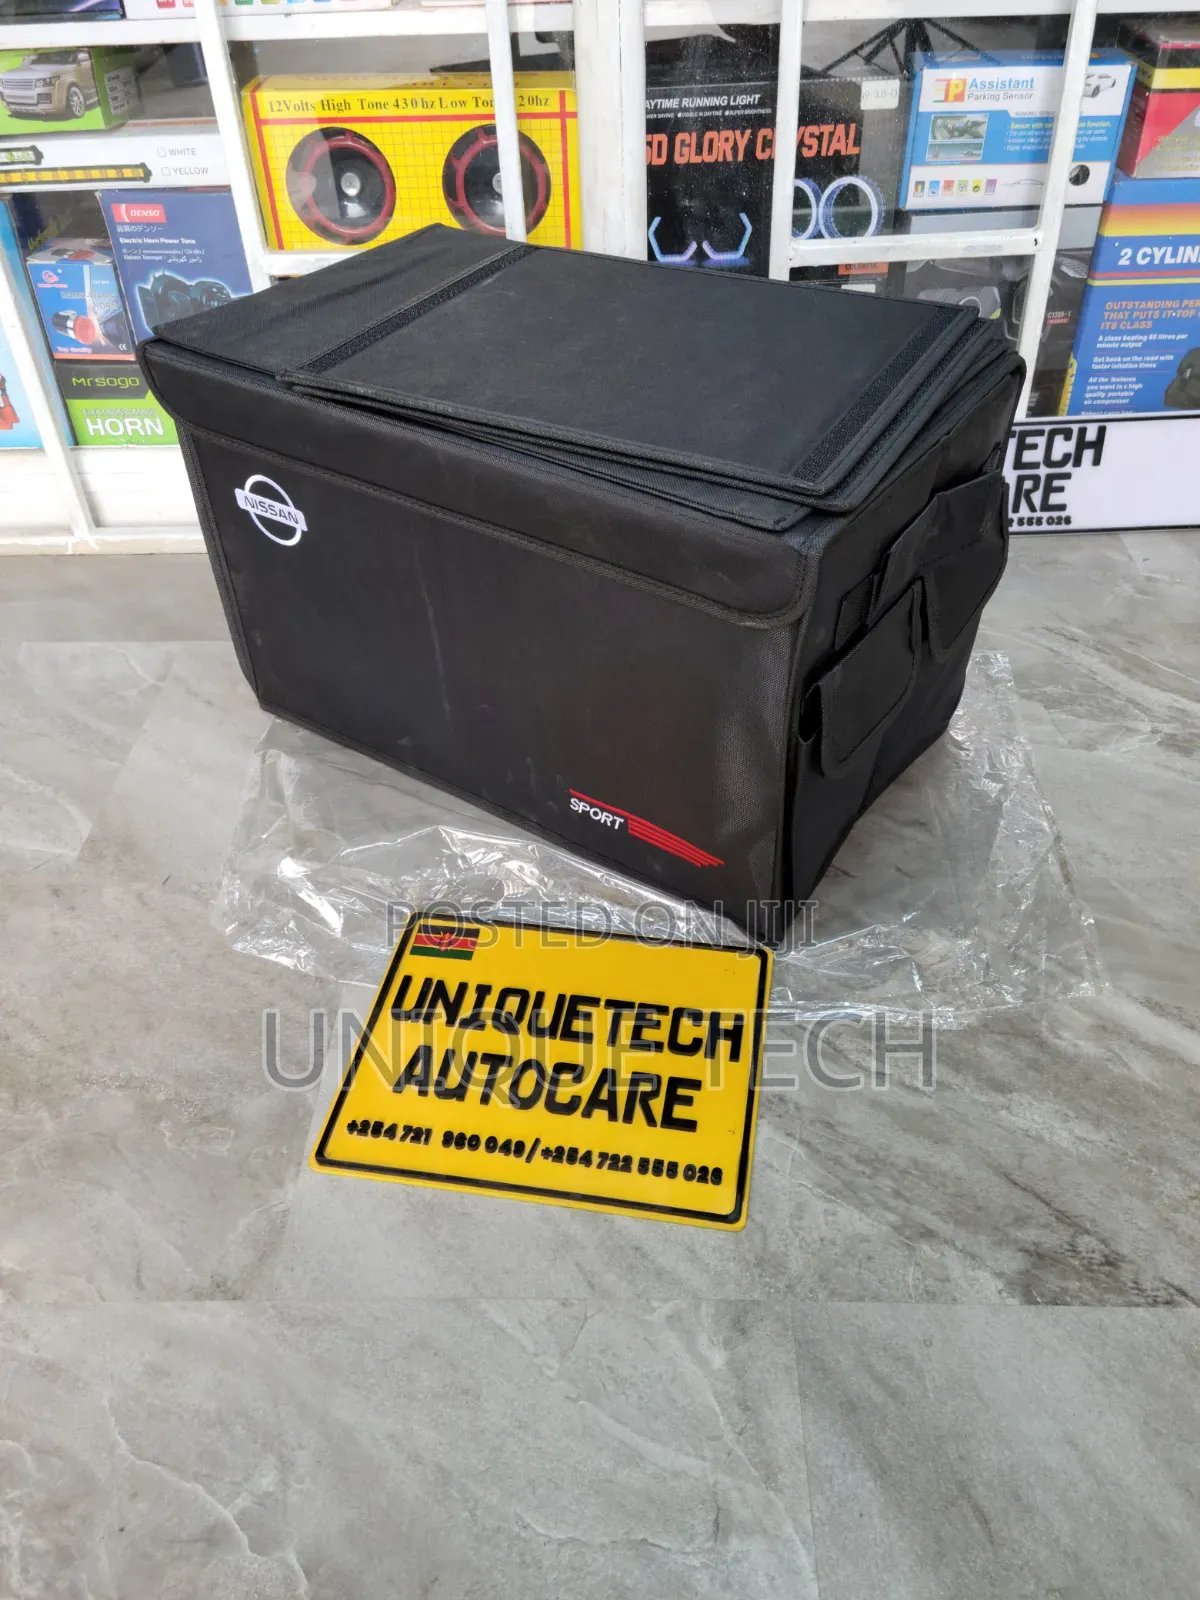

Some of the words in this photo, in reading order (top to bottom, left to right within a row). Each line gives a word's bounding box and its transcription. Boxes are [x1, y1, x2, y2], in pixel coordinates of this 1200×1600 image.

[968, 77, 1035, 90] Assistant
[645, 98, 680, 110] AYTIME
[682, 97, 728, 108] RUNNING
[730, 94, 761, 105] LIGHT
[967, 92, 1000, 102] Parking
[1002, 91, 1033, 100] Sensor
[268, 99, 316, 113] 12Volts
[320, 99, 351, 113] High
[357, 98, 389, 112] Tone
[439, 96, 468, 109] Low
[517, 94, 550, 107] 20hz
[1010, 121, 1031, 129] Sensor
[674, 129, 752, 165] GLORY
[755, 123, 860, 160] CSTAL
[168, 148, 197, 156] WHITE
[172, 166, 209, 176] YELLOW
[130, 209, 160, 217] DENSO
[159, 237, 179, 245] Power
[1117, 247, 1133, 266] 2
[1136, 245, 1200, 265] CYLIN
[1105, 300, 1179, 310] OUTSTANDING
[1103, 311, 1130, 320] THAT
[1132, 310, 1160, 319] PUTS
[1162, 310, 1174, 318] IT
[1175, 309, 1195, 318] TOP
[1100, 321, 1118, 330] ITS
[1119, 320, 1153, 329] CLASS
[1104, 334, 1121, 342] class
[1122, 334, 1148, 342] beating
[1175, 333, 1188, 341] per
[71, 377, 140, 389] Mrsogo
[1128, 383, 1143, 391] high
[85, 418, 164, 436] HORN
[1011, 472, 1072, 514] RE
[244, 495, 299, 525] NISSAN
[1016, 516, 1044, 527] 555
[1045, 515, 1072, 526] 026
[569, 797, 625, 830] SPORT
[391, 974, 744, 1063] UNIQUETECH
[392, 1045, 702, 1133] AUTOCARE
[346, 1119, 398, 1141] +254
[399, 1124, 433, 1146] 721
[596, 1151, 633, 1173] 722
[637, 1157, 679, 1179] 555
[683, 1163, 723, 1186] 026
